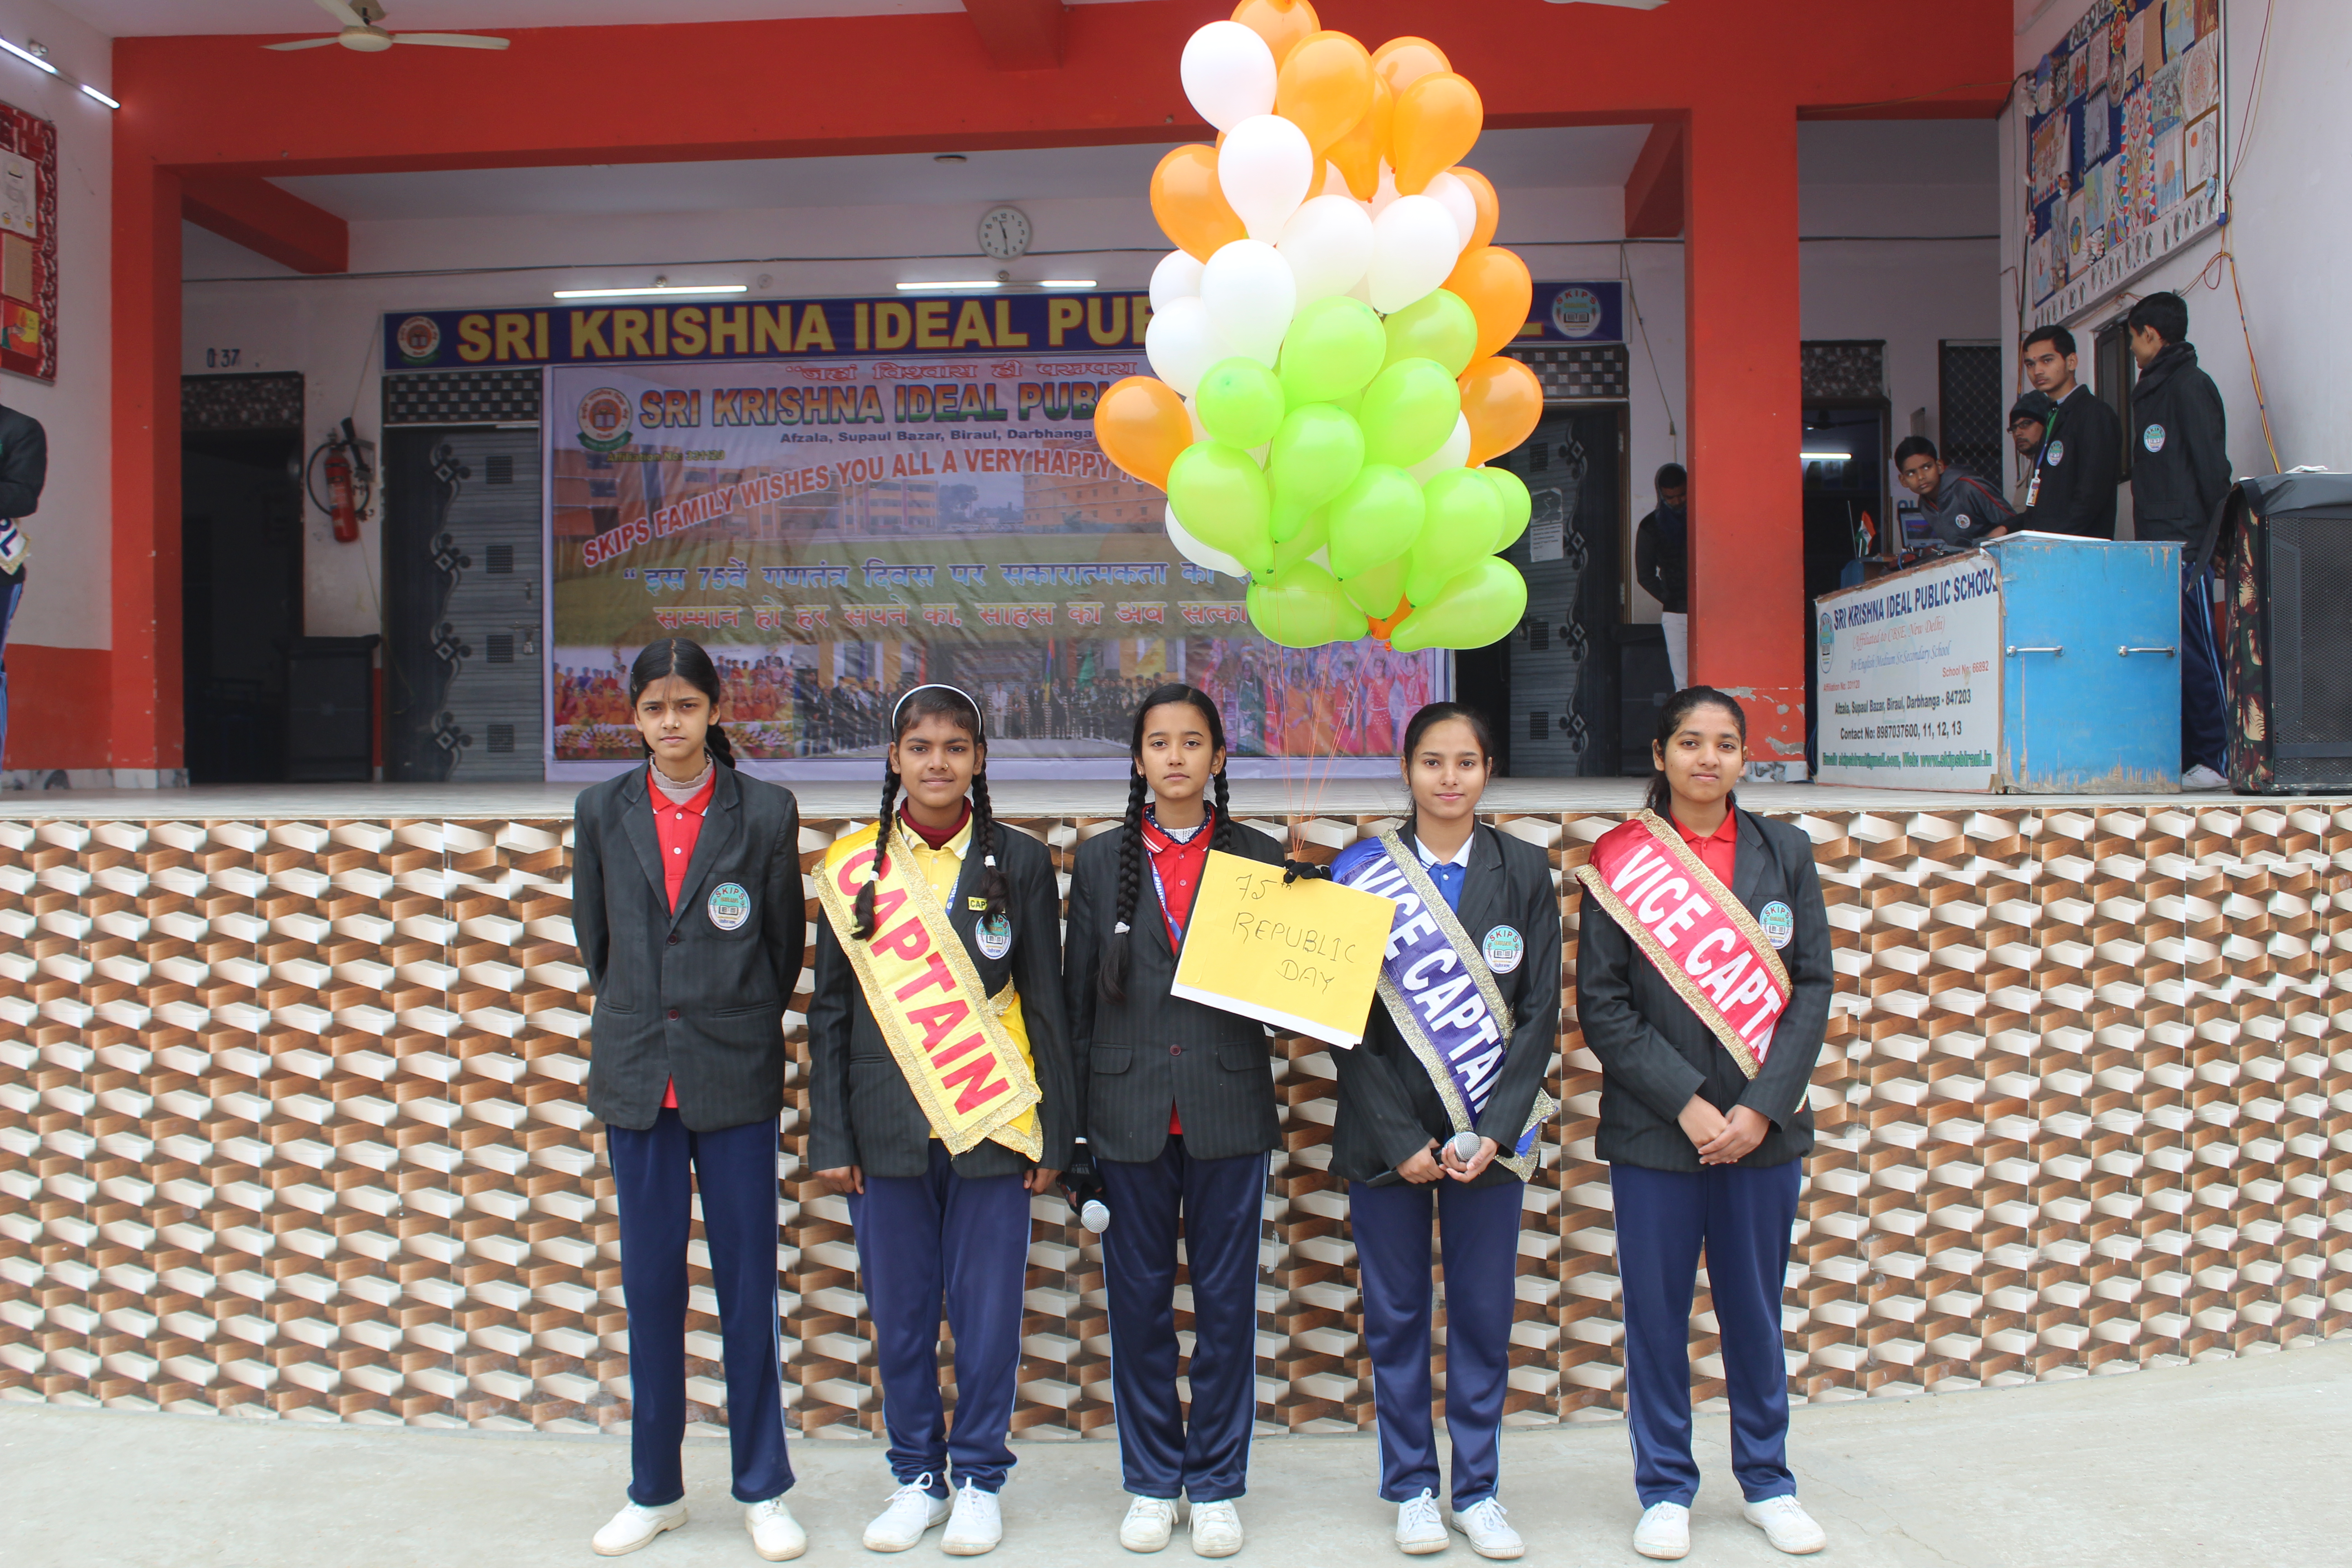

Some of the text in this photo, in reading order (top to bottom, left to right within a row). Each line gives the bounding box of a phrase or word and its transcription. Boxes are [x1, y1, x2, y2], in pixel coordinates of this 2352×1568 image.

[457, 312, 549, 362] SRI
[570, 303, 836, 358] KRISHNA
[853, 298, 1029, 351] IDEAL
[991, 360, 1023, 378] ही
[639, 389, 701, 429] SRI
[712, 385, 885, 427] KRISHNA
[895, 382, 1008, 423] IDEAL
[780, 428, 1093, 443] Afzala, Supaul Bazar, Biraul, Darbhanga
[583, 517, 651, 567] SKIPS
[653, 485, 736, 538] FAMILY
[739, 464, 831, 508] WISHES
[835, 455, 885, 486] YOU
[892, 451, 935, 478] ALL
[941, 449, 958, 474] A
[964, 448, 1027, 473] VERY
[1034, 448, 1114, 480] HAPPY
[860, 558, 938, 591] दिवस
[947, 564, 988, 587] पर
[653, 605, 743, 629] सम्मान
[794, 605, 830, 630] हर
[841, 593, 911, 627] सपने
[974, 602, 1057, 629] साहस
[1066, 601, 1104, 625] का
[1114, 601, 1168, 624] अब
[1178, 600, 1247, 624] सत्का
[1834, 608, 1846, 631] SRI
[1848, 598, 1884, 627] KRISHNA
[1886, 591, 1912, 619] IDEAL
[1915, 579, 1950, 612] PUBLIC
[1931, 640, 1951, 660] School
[1942, 665, 1961, 678] School
[1972, 661, 1989, 673] 66892
[1823, 681, 1840, 692] Affiliation
[1847, 680, 1860, 689] 331120
[1835, 702, 1851, 716] Afzala,
[1852, 701, 1868, 716] Supaul
[1869, 700, 1885, 714] Bazar,
[1886, 696, 1905, 712] Biraul,
[1906, 694, 1940, 710] Darbhanga
[1946, 688, 1971, 706] 847203
[1840, 720, 1962, 740] Contact No: 8987037600, 11, 12, 13
[715, 887, 745, 900] SKIPS
[1611, 844, 1712, 948] VICE
[1765, 906, 1790, 919] SKIPS
[1233, 912, 1355, 963] REPUBLIC
[1490, 930, 1519, 942] SKIPS
[838, 848, 1011, 1116] CAPTAIN
[1275, 960, 1334, 995] DAY
